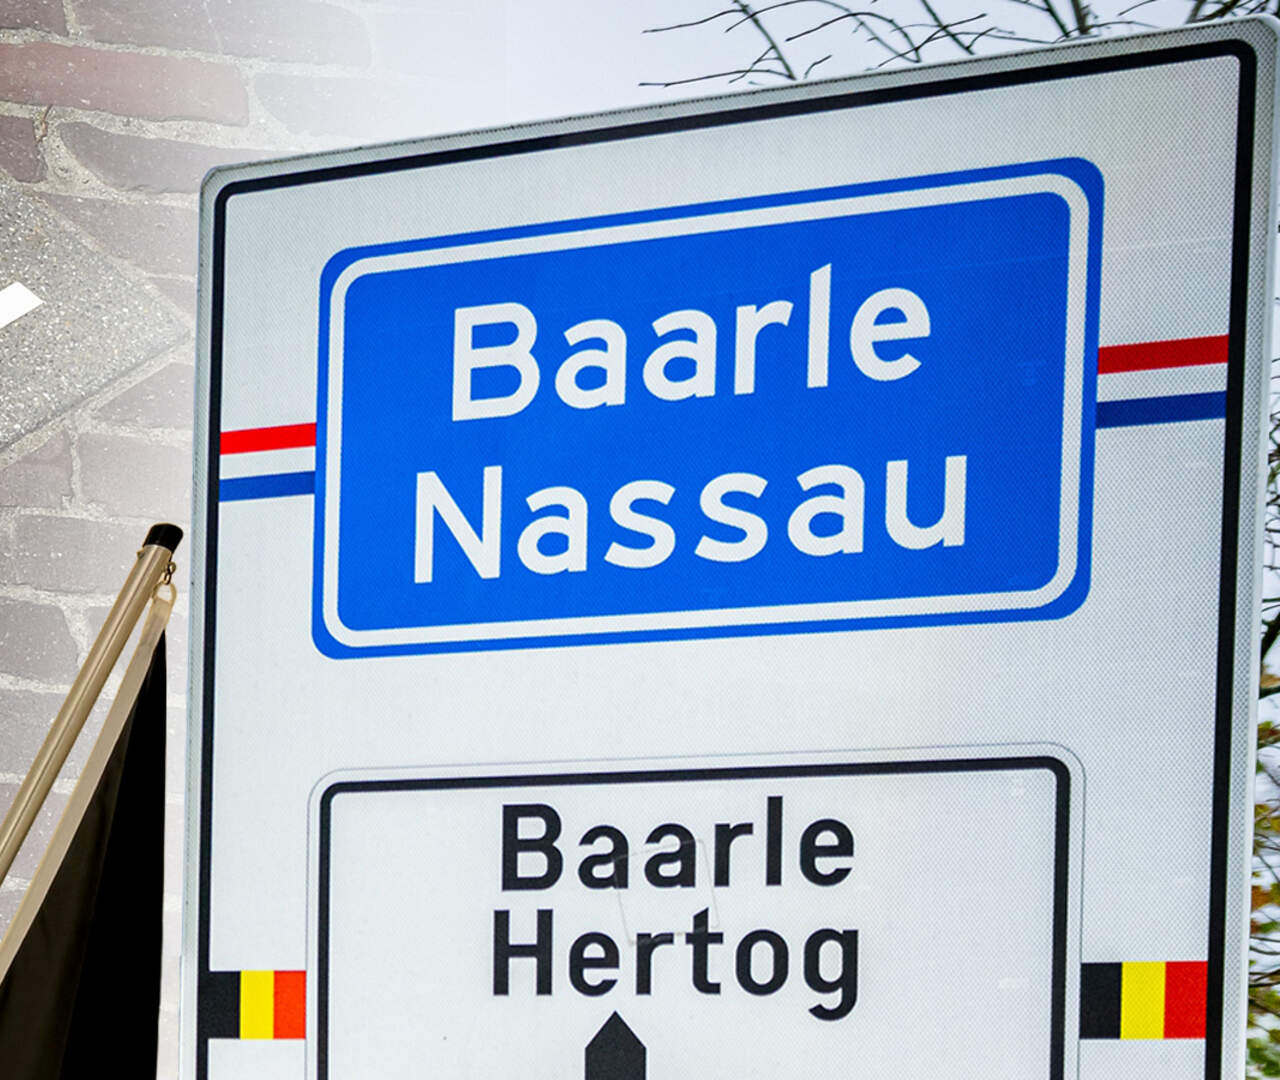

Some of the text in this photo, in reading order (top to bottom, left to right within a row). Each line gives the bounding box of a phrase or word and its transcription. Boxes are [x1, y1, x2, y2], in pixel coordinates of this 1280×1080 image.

[452, 262, 931, 422] Baarle
[414, 454, 968, 584] Nassau
[500, 795, 856, 892] Baarle
[492, 906, 860, 1022] Hertog
